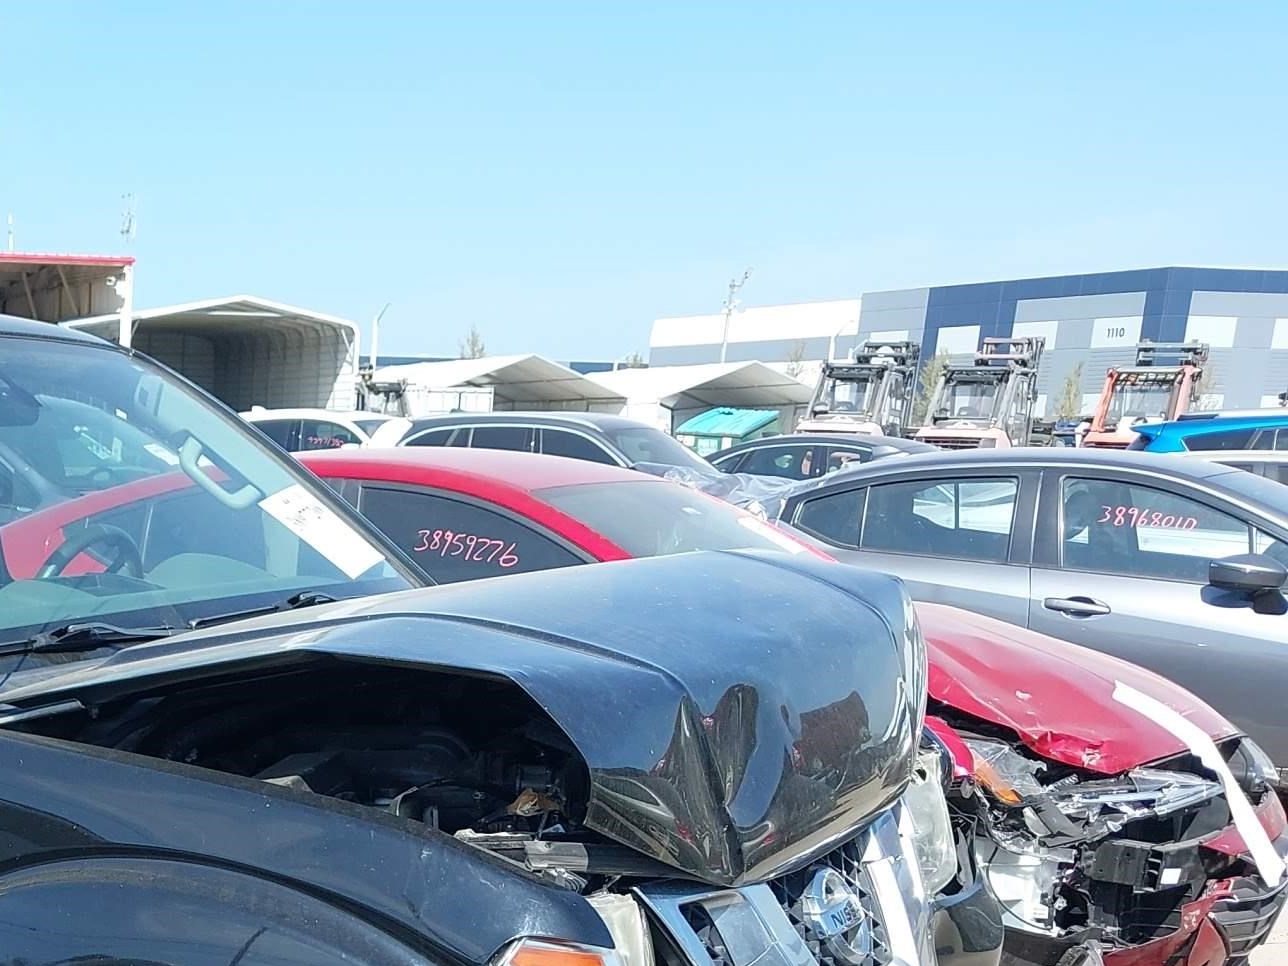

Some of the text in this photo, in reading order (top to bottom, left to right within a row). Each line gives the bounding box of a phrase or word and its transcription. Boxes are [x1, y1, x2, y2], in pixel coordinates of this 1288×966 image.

[1106, 326, 1126, 339] 1110
[1096, 505, 1198, 530] 38968010
[413, 529, 519, 567] 38959276
